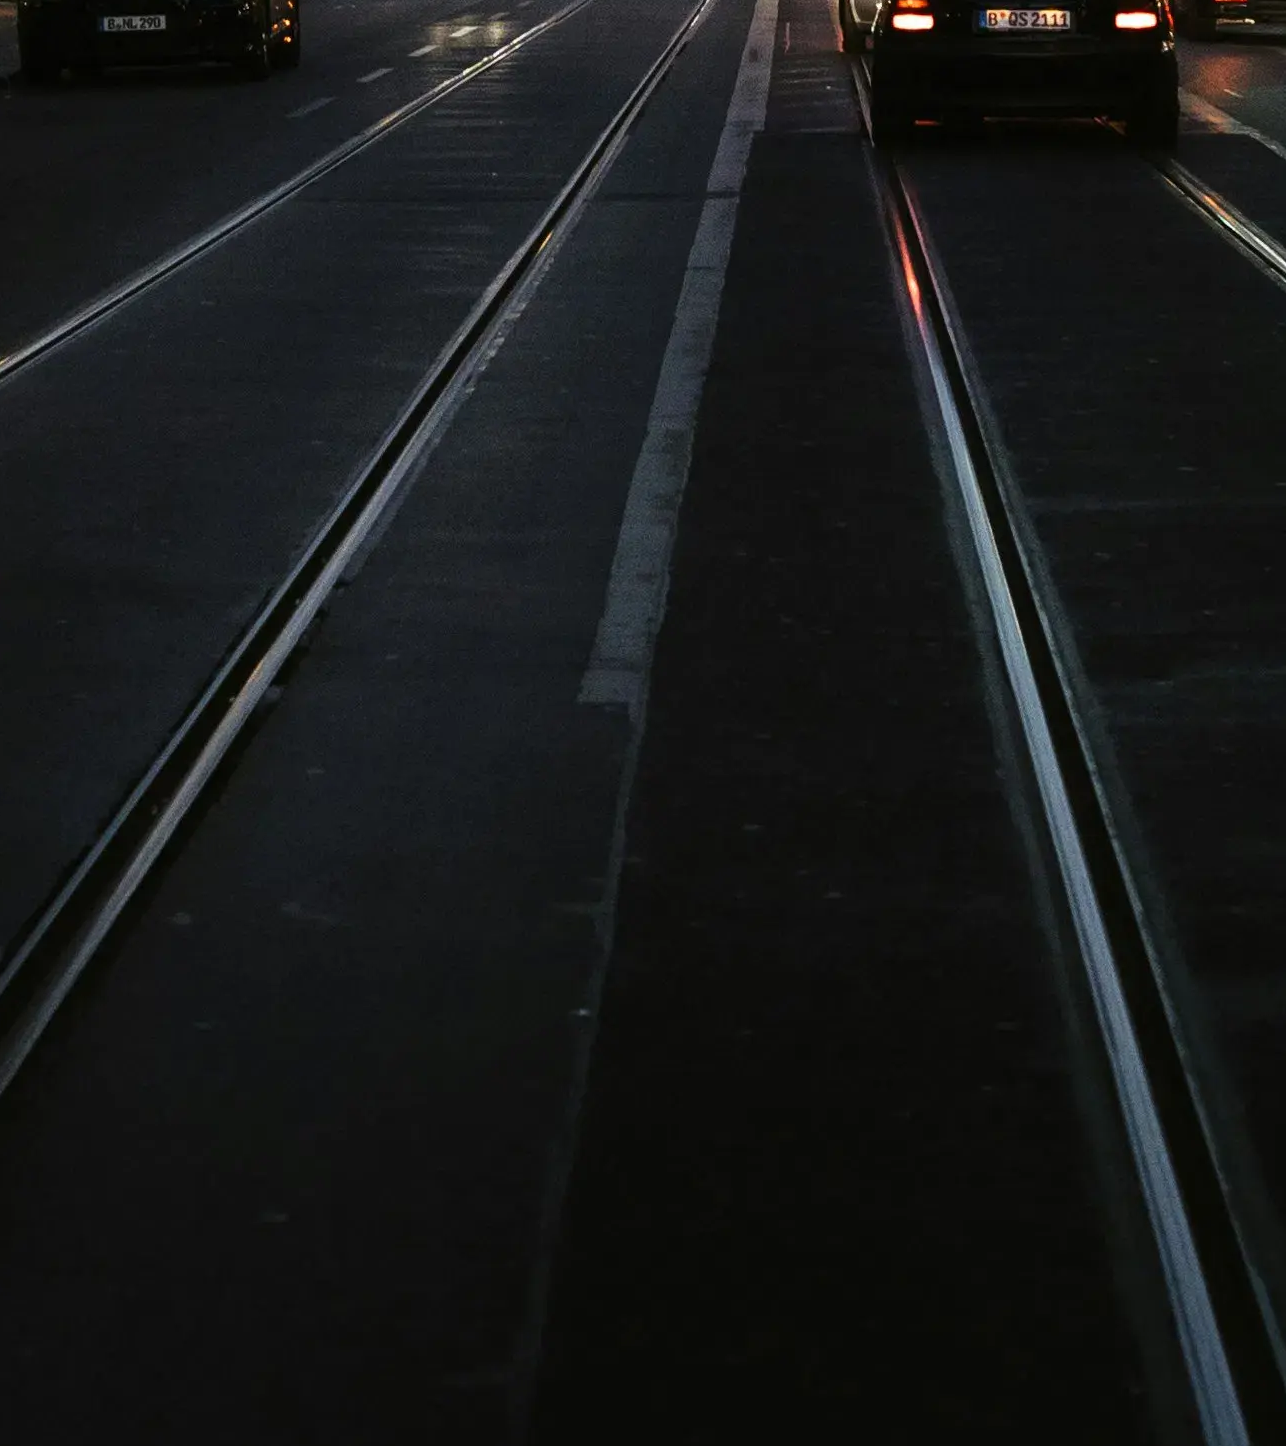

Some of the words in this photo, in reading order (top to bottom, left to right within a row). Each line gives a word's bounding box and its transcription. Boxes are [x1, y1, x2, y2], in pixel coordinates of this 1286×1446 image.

[140, 16, 161, 29] 290
[988, 12, 998, 27] B
[1008, 11, 1028, 27] QS
[1031, 12, 1068, 27] 2111
